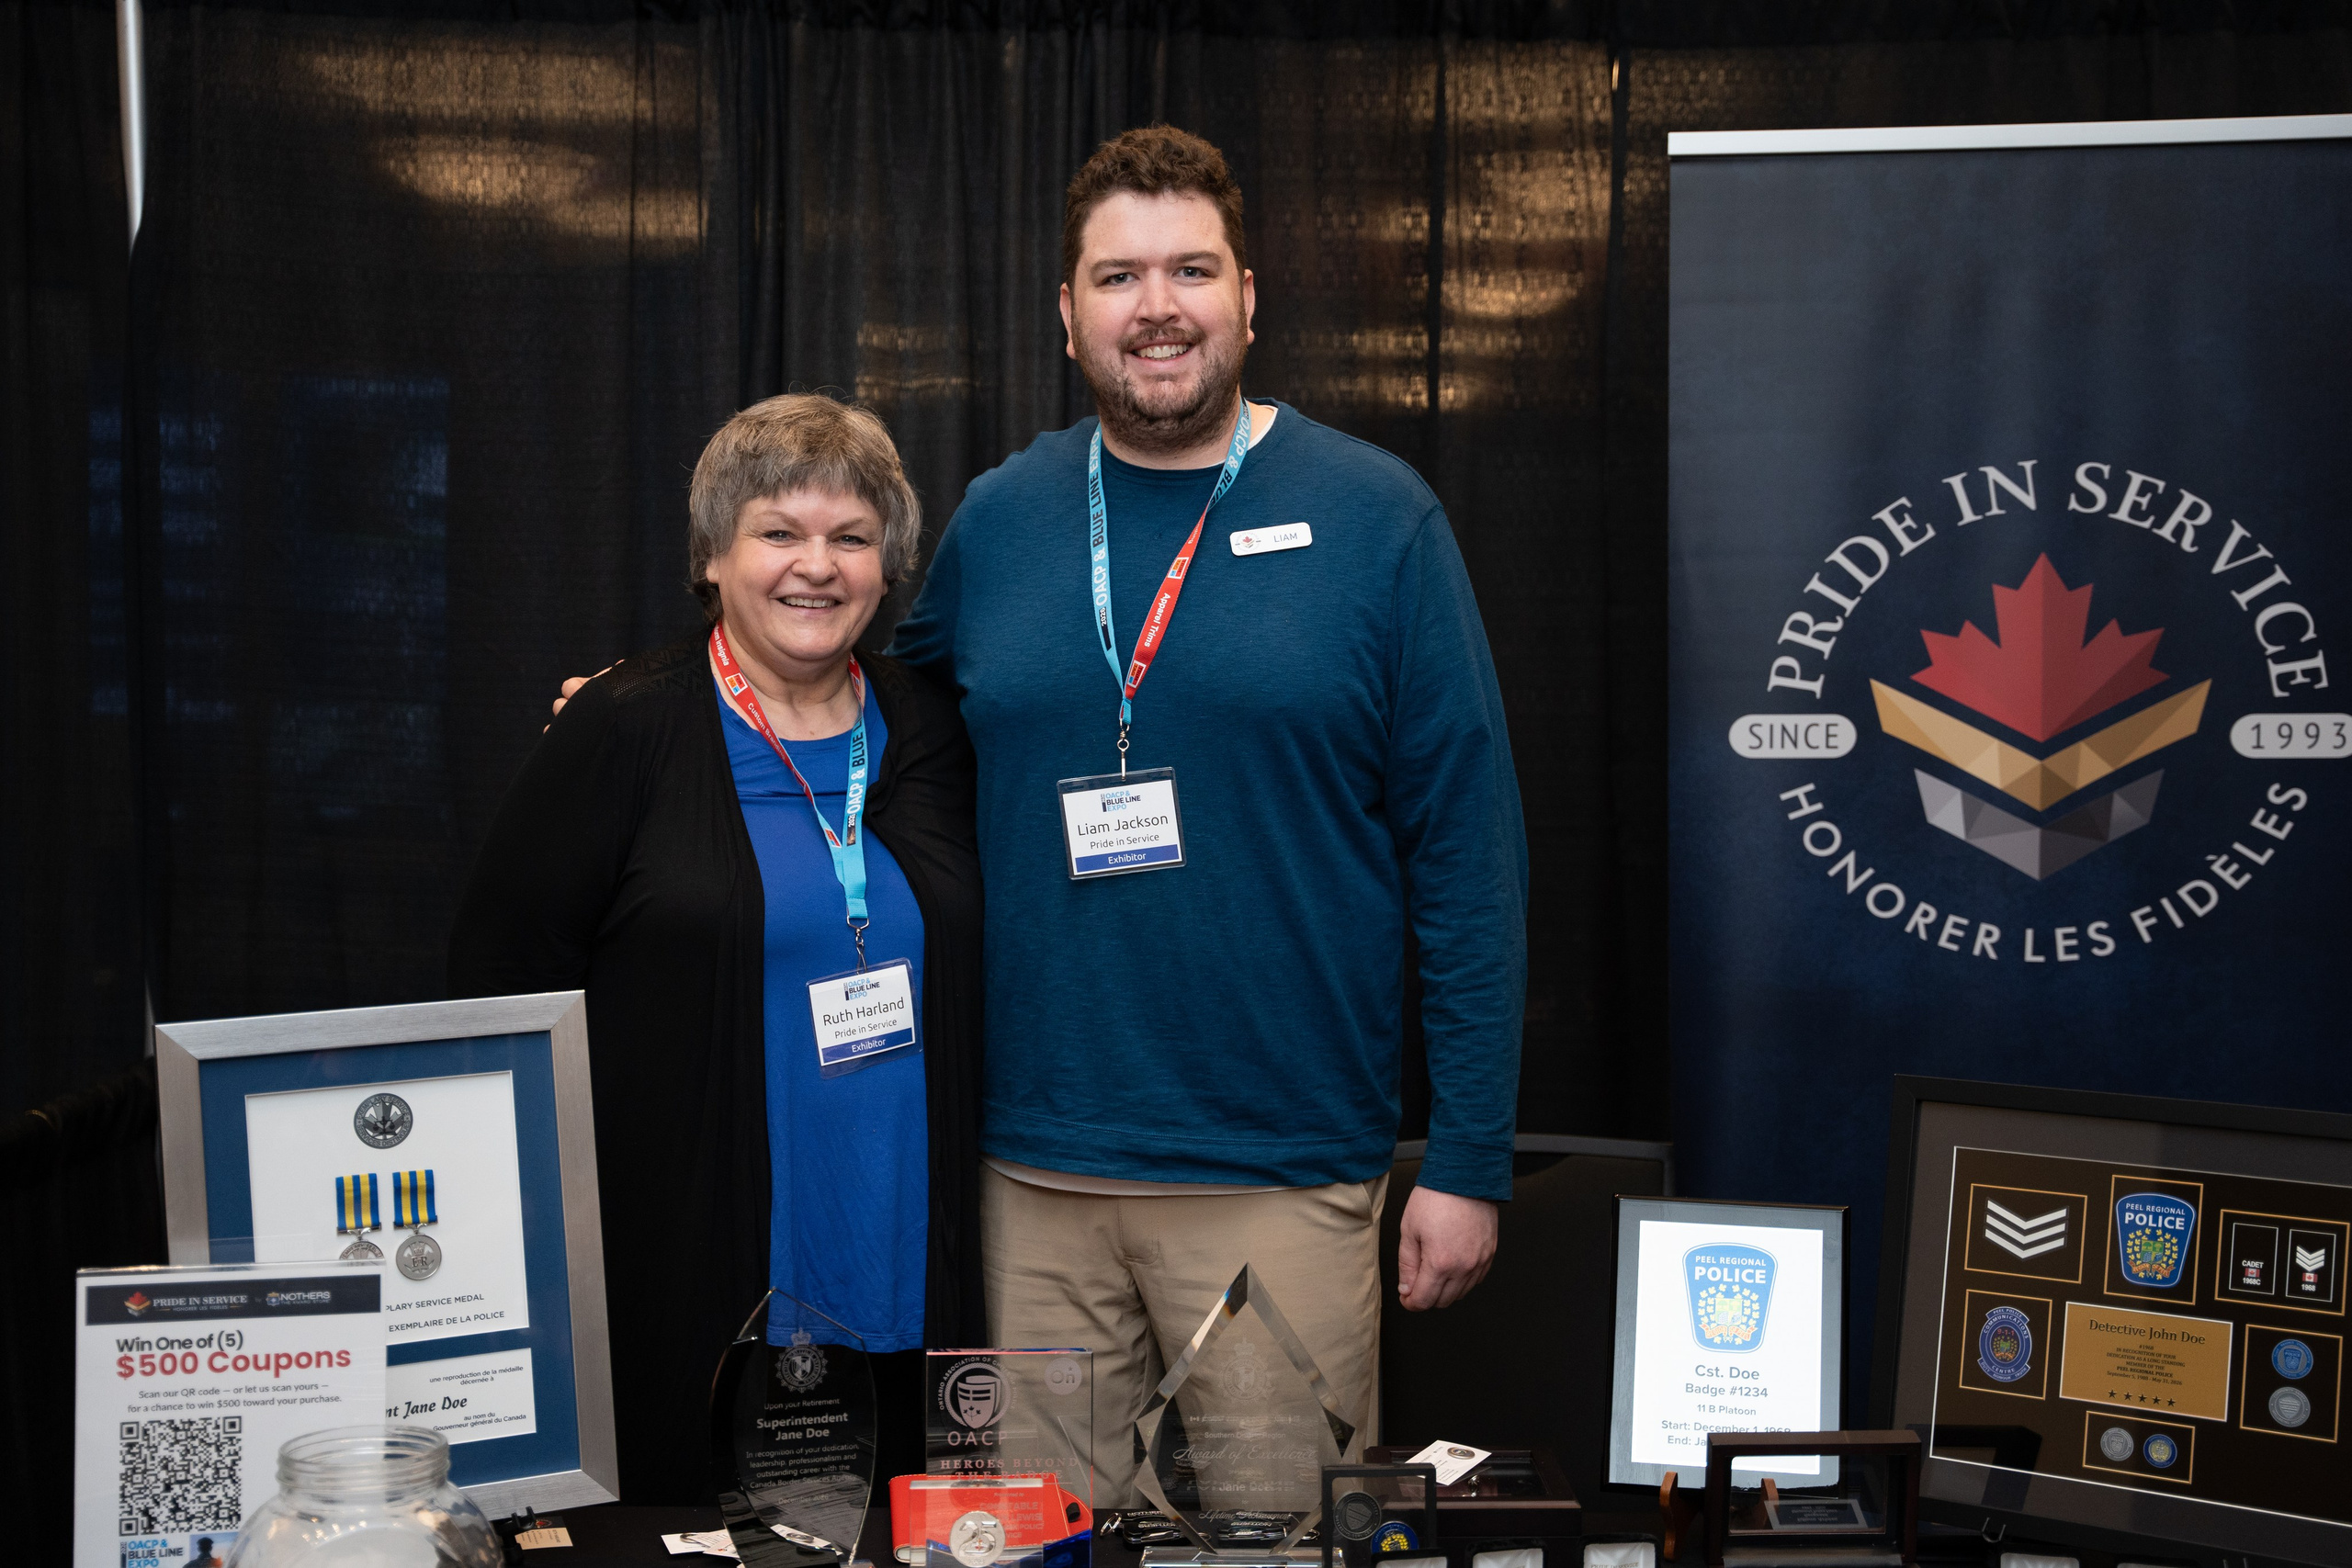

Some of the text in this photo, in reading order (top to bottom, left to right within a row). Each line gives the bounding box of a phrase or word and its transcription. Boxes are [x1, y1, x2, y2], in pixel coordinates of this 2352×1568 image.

[1234, 417, 1250, 456] OACP
[1090, 431, 1107, 606] OACP BLUE LINE EXPO
[1273, 533, 1298, 543] LIAM
[1767, 458, 2330, 700] PRIDE IN SERVICE
[1144, 592, 1171, 648] Apparel Trims
[748, 703, 765, 729] Custom
[1748, 722, 1839, 750] SINCE
[2250, 721, 2349, 750] 1993
[852, 732, 865, 768] BLUE
[848, 783, 863, 814] OACP
[1106, 797, 1125, 806] BLUE
[1078, 816, 1169, 836] Liam Jackson
[1090, 833, 1159, 849] Pride in Service
[1108, 852, 1146, 864] Exhibitor
[1779, 783, 2309, 964] HONORER LES FIDÈLES
[849, 986, 865, 994] BLUE
[865, 982, 880, 990] LINE
[849, 991, 867, 1000] EXPO
[822, 997, 905, 1026] Ruth Harland
[834, 1018, 897, 1039] Pride in Service
[852, 1038, 886, 1053] Exhibitor
[2126, 1202, 2186, 1215] PEEL REGIONAL
[2124, 1213, 2185, 1230] POLICE
[1695, 1256, 1767, 1266] PEEL REGIONAL
[2242, 1260, 2264, 1269] CADET
[1694, 1267, 1767, 1284] POLICE
[153, 1298, 186, 1306] PRIDE
[188, 1297, 200, 1305] IN
[202, 1295, 247, 1304] SERVICE
[280, 1292, 331, 1301] NOTHERS
[415, 1293, 484, 1308] SERVICE MEDAL
[389, 1319, 444, 1332] EXEMPLAIRE
[459, 1315, 471, 1324] LA
[473, 1311, 504, 1321] POLICE
[1984, 1314, 2029, 1339] COMMUNICATIONS
[2089, 1319, 2206, 1345] Detective John Doe
[116, 1330, 243, 1353] Win One of (5)
[2106, 1352, 2135, 1360] DEDICATION
[2122, 1348, 2155, 1357] RECOGNITION
[117, 1349, 351, 1381] $500 Coupons
[943, 1357, 980, 1382] ASSOCIATION
[1695, 1364, 1759, 1381] Cst. Doe
[1992, 1365, 2015, 1374] CENTRE
[443, 1371, 481, 1382] reproduction
[498, 1365, 524, 1374] médaille
[460, 1377, 489, 1385] décernée
[2107, 1371, 2131, 1379] September
[139, 1391, 160, 1399] Scan
[181, 1388, 196, 1398] QR
[198, 1387, 220, 1395] code
[245, 1385, 257, 1393] let
[272, 1384, 291, 1393] scan
[294, 1382, 319, 1393] yours
[1685, 1383, 1768, 1398] Badge #1234
[128, 1404, 141, 1413] for
[151, 1403, 184, 1412] chance
[198, 1400, 214, 1409] win
[217, 1398, 240, 1409] $500
[243, 1397, 275, 1407] toward
[277, 1398, 297, 1407] your
[300, 1394, 342, 1404] purchase.
[402, 1396, 468, 1419] Jane Doe
[764, 1398, 840, 1411] Upon your Retirement
[1718, 1405, 1757, 1416] Platoon
[433, 1421, 469, 1432] Gouverneur
[470, 1417, 492, 1428] général
[503, 1414, 526, 1422] Canada
[756, 1413, 848, 1430] Superintendent
[1661, 1420, 1749, 1433] Start: December
[775, 1428, 830, 1441] Jane Doe
[947, 1430, 1008, 1446] OACP
[1668, 1435, 1691, 1445] End:
[754, 1447, 820, 1458] recognition your
[1172, 1444, 1317, 1464] Award of Excellence
[788, 1455, 842, 1466] professionalism
[940, 1458, 1079, 1470] HEROES BEYOND
[756, 1469, 798, 1478] outstanding
[955, 1470, 1063, 1481] THE BADGE
[750, 1478, 801, 1489] Canada Border
[1218, 1483, 1245, 1491] Jane
[1198, 1508, 1236, 1522] Lifetime
[129, 1540, 159, 1551] OACP
[128, 1547, 184, 1560] BLUE LINE
[129, 1558, 159, 1568] EXPO
